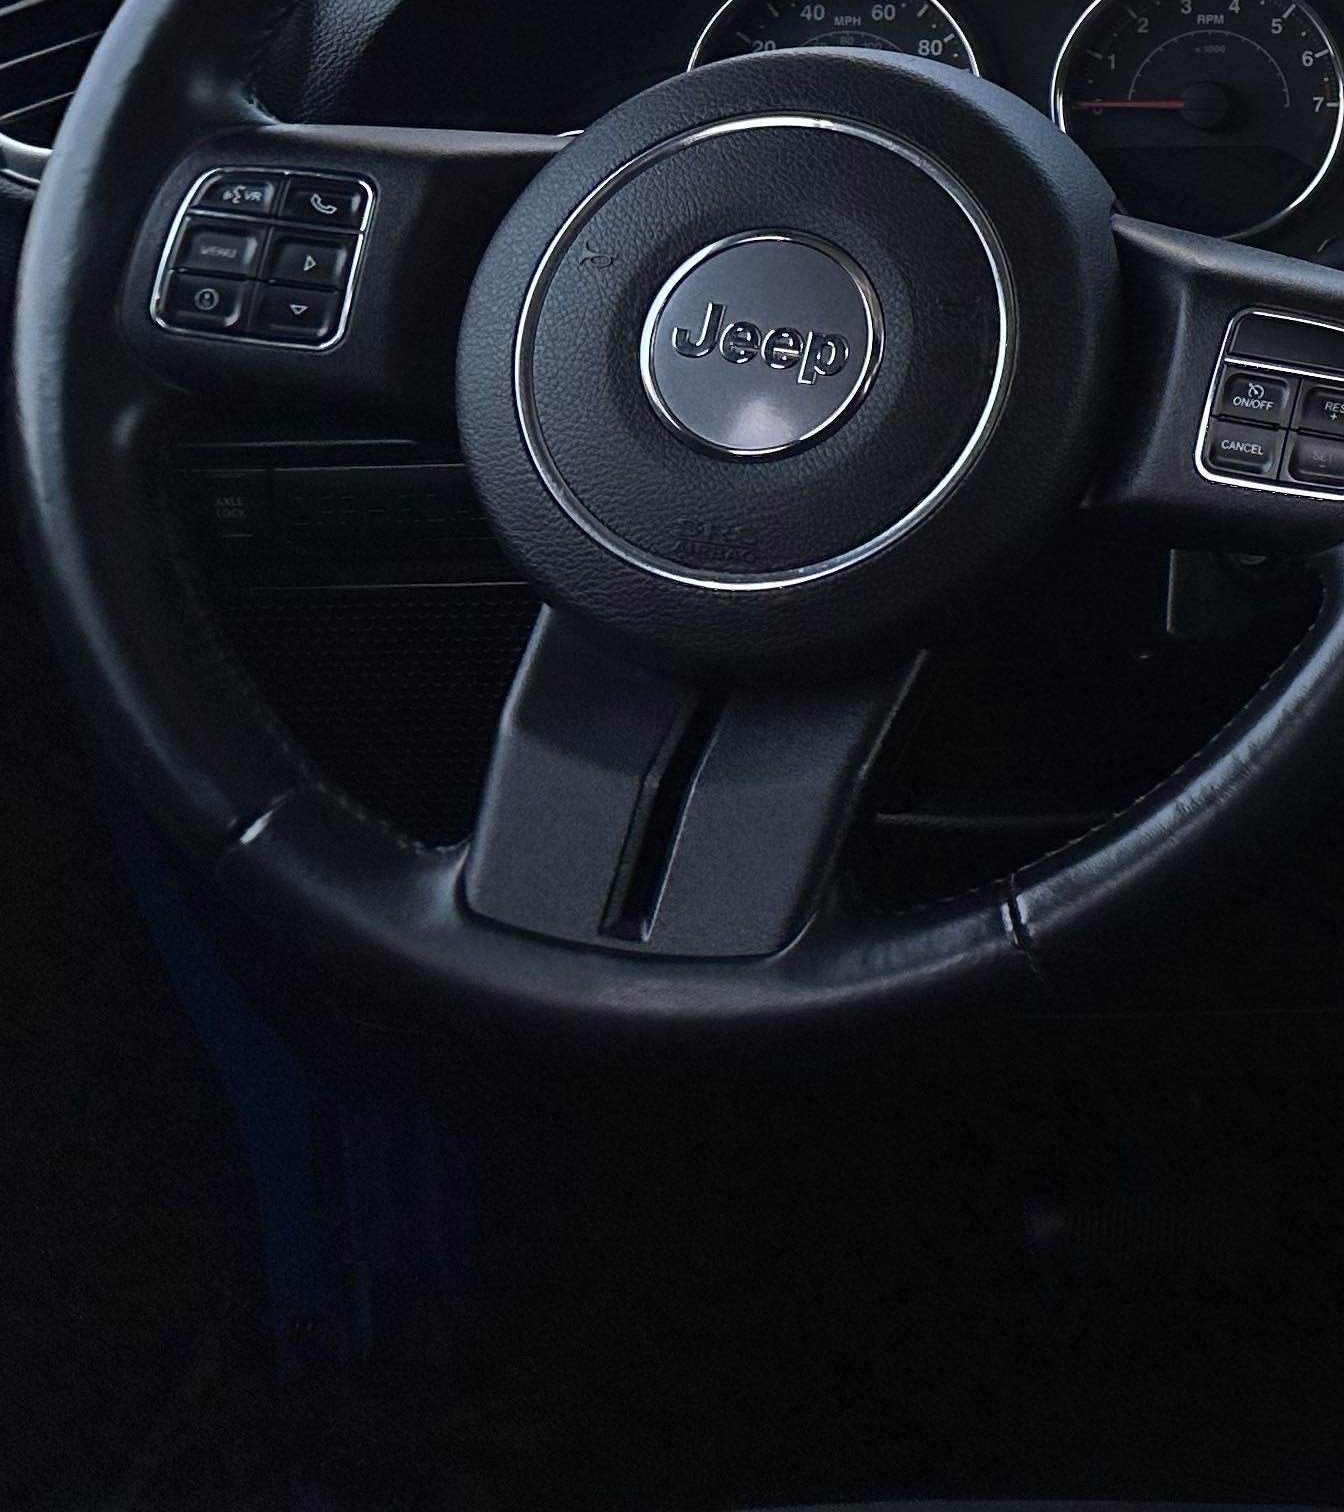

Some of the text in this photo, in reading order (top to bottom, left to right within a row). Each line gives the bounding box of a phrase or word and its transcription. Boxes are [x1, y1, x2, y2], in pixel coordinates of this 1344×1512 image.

[800, 3, 825, 21] 40
[871, 3, 896, 21] 60
[1179, 0, 1192, 15] 3
[833, 15, 862, 27] MPH
[1137, 17, 1149, 33] 2
[1196, 14, 1225, 25] RPM
[1271, 18, 1283, 34] 5
[917, 39, 943, 56] 80
[1107, 54, 1116, 70] 1
[1302, 51, 1314, 67] 6
[1312, 96, 1324, 113] 7
[244, 190, 263, 202] VR
[200, 246, 238, 258] MENU
[671, 301, 849, 386] Jeep
[1232, 396, 1274, 411] ON/OFF
[1221, 439, 1264, 456] CANCEL
[1312, 449, 1334, 462] SET
